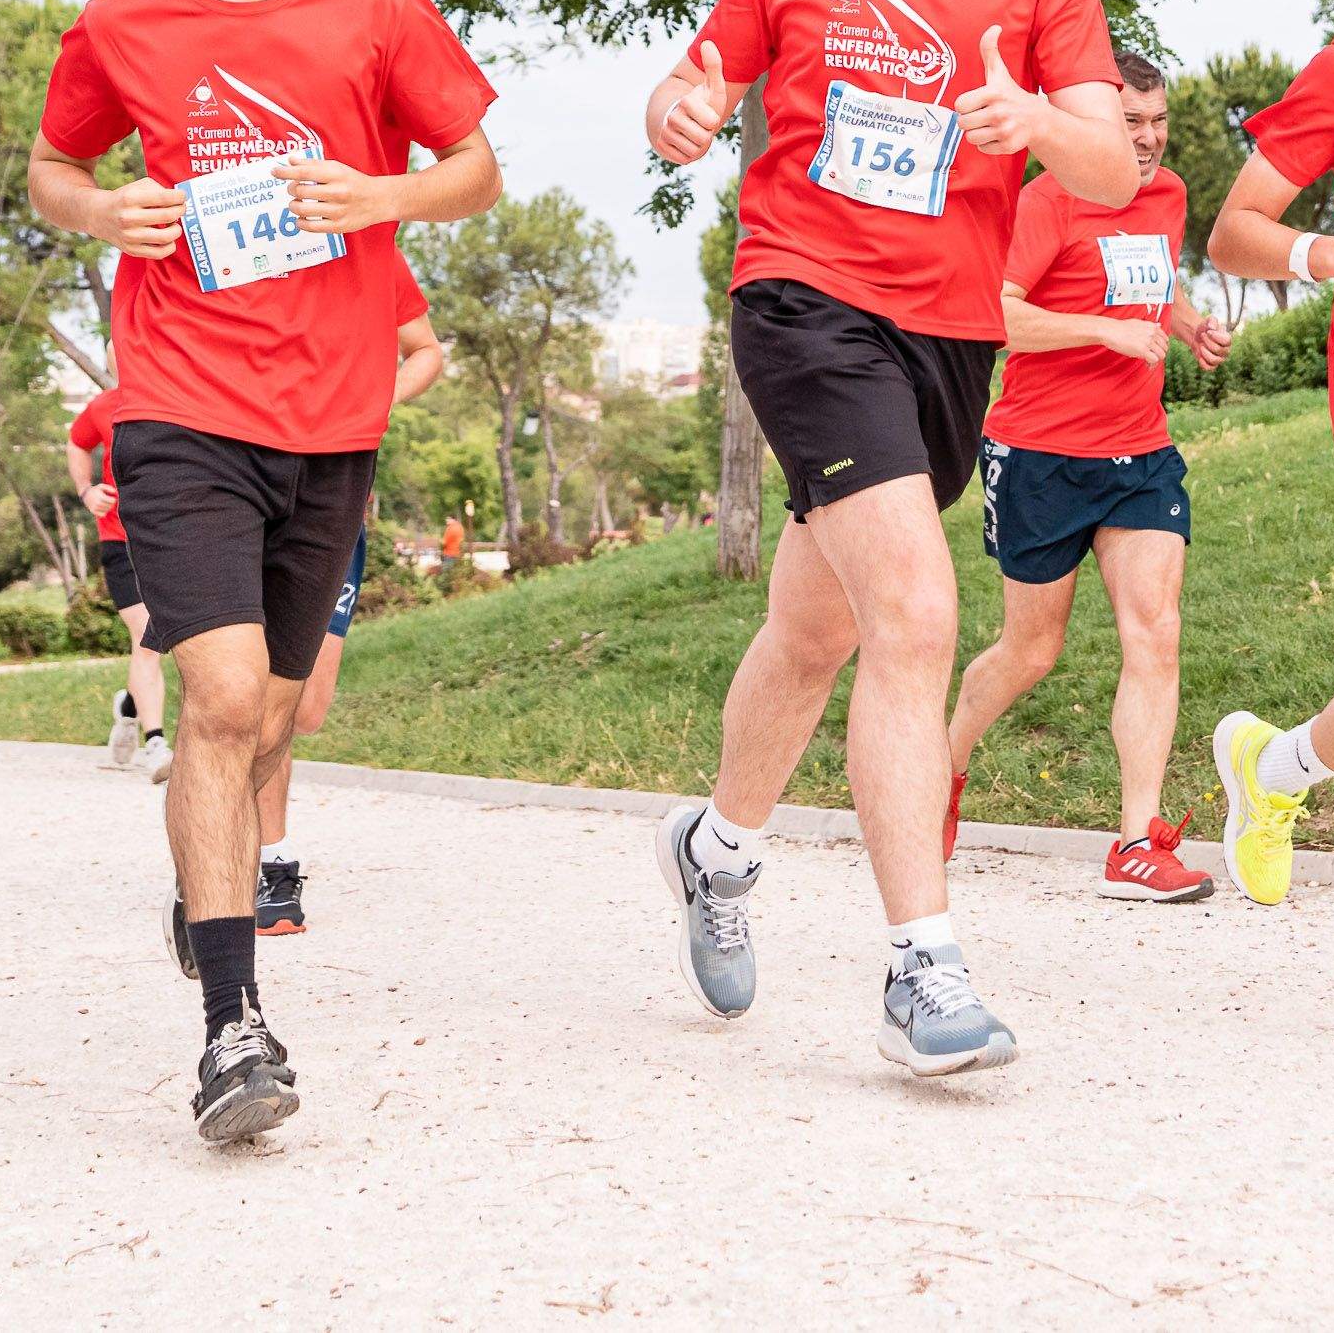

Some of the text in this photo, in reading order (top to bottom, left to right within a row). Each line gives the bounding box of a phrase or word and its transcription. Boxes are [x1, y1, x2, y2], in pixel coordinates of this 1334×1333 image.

[872, 26, 884, 39] de
[824, 37, 950, 66] ENFERMEDADES
[825, 53, 927, 80] REUMÁTICAS
[827, 94, 842, 118] 10K
[841, 102, 925, 128] ENFERMEDADES
[235, 124, 246, 137] de
[839, 113, 906, 135] REUMATICAS
[188, 139, 317, 157] ENFERMEDADES
[851, 137, 916, 177] 156
[199, 178, 287, 206] ENFERMEDADES
[202, 191, 275, 217] REUMATICAS
[227, 207, 301, 250] 146
[187, 223, 212, 276] CARRERA
[295, 244, 326, 259] MADRID
[1126, 265, 1159, 284] 110
[822, 457, 855, 477] KUIKMA
